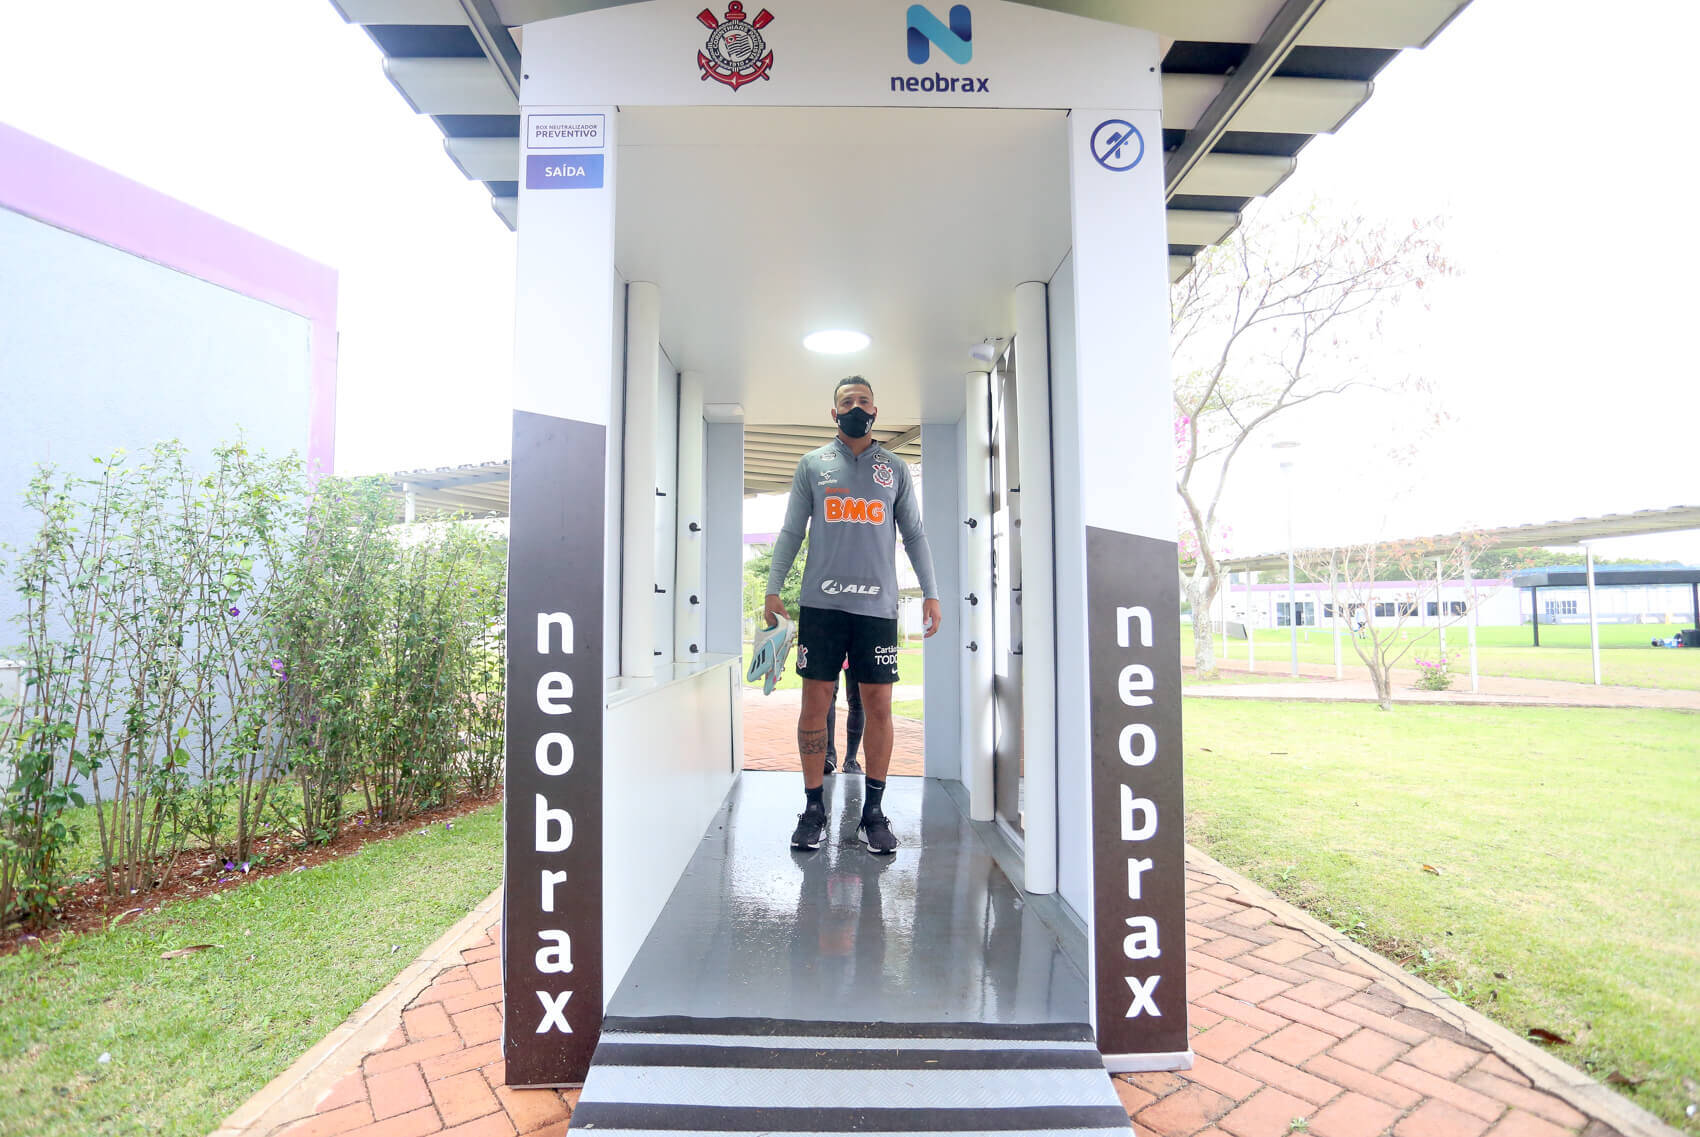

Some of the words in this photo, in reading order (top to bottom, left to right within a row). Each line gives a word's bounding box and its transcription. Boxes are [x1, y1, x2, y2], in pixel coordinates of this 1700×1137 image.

[890, 72, 990, 93] neobrax
[536, 130, 598, 138] PREVENTIVO
[544, 164, 586, 177] SAÍDA
[824, 496, 886, 525] BMG
[535, 611, 575, 1034] neobrax
[1116, 605, 1162, 1018] neobrax
